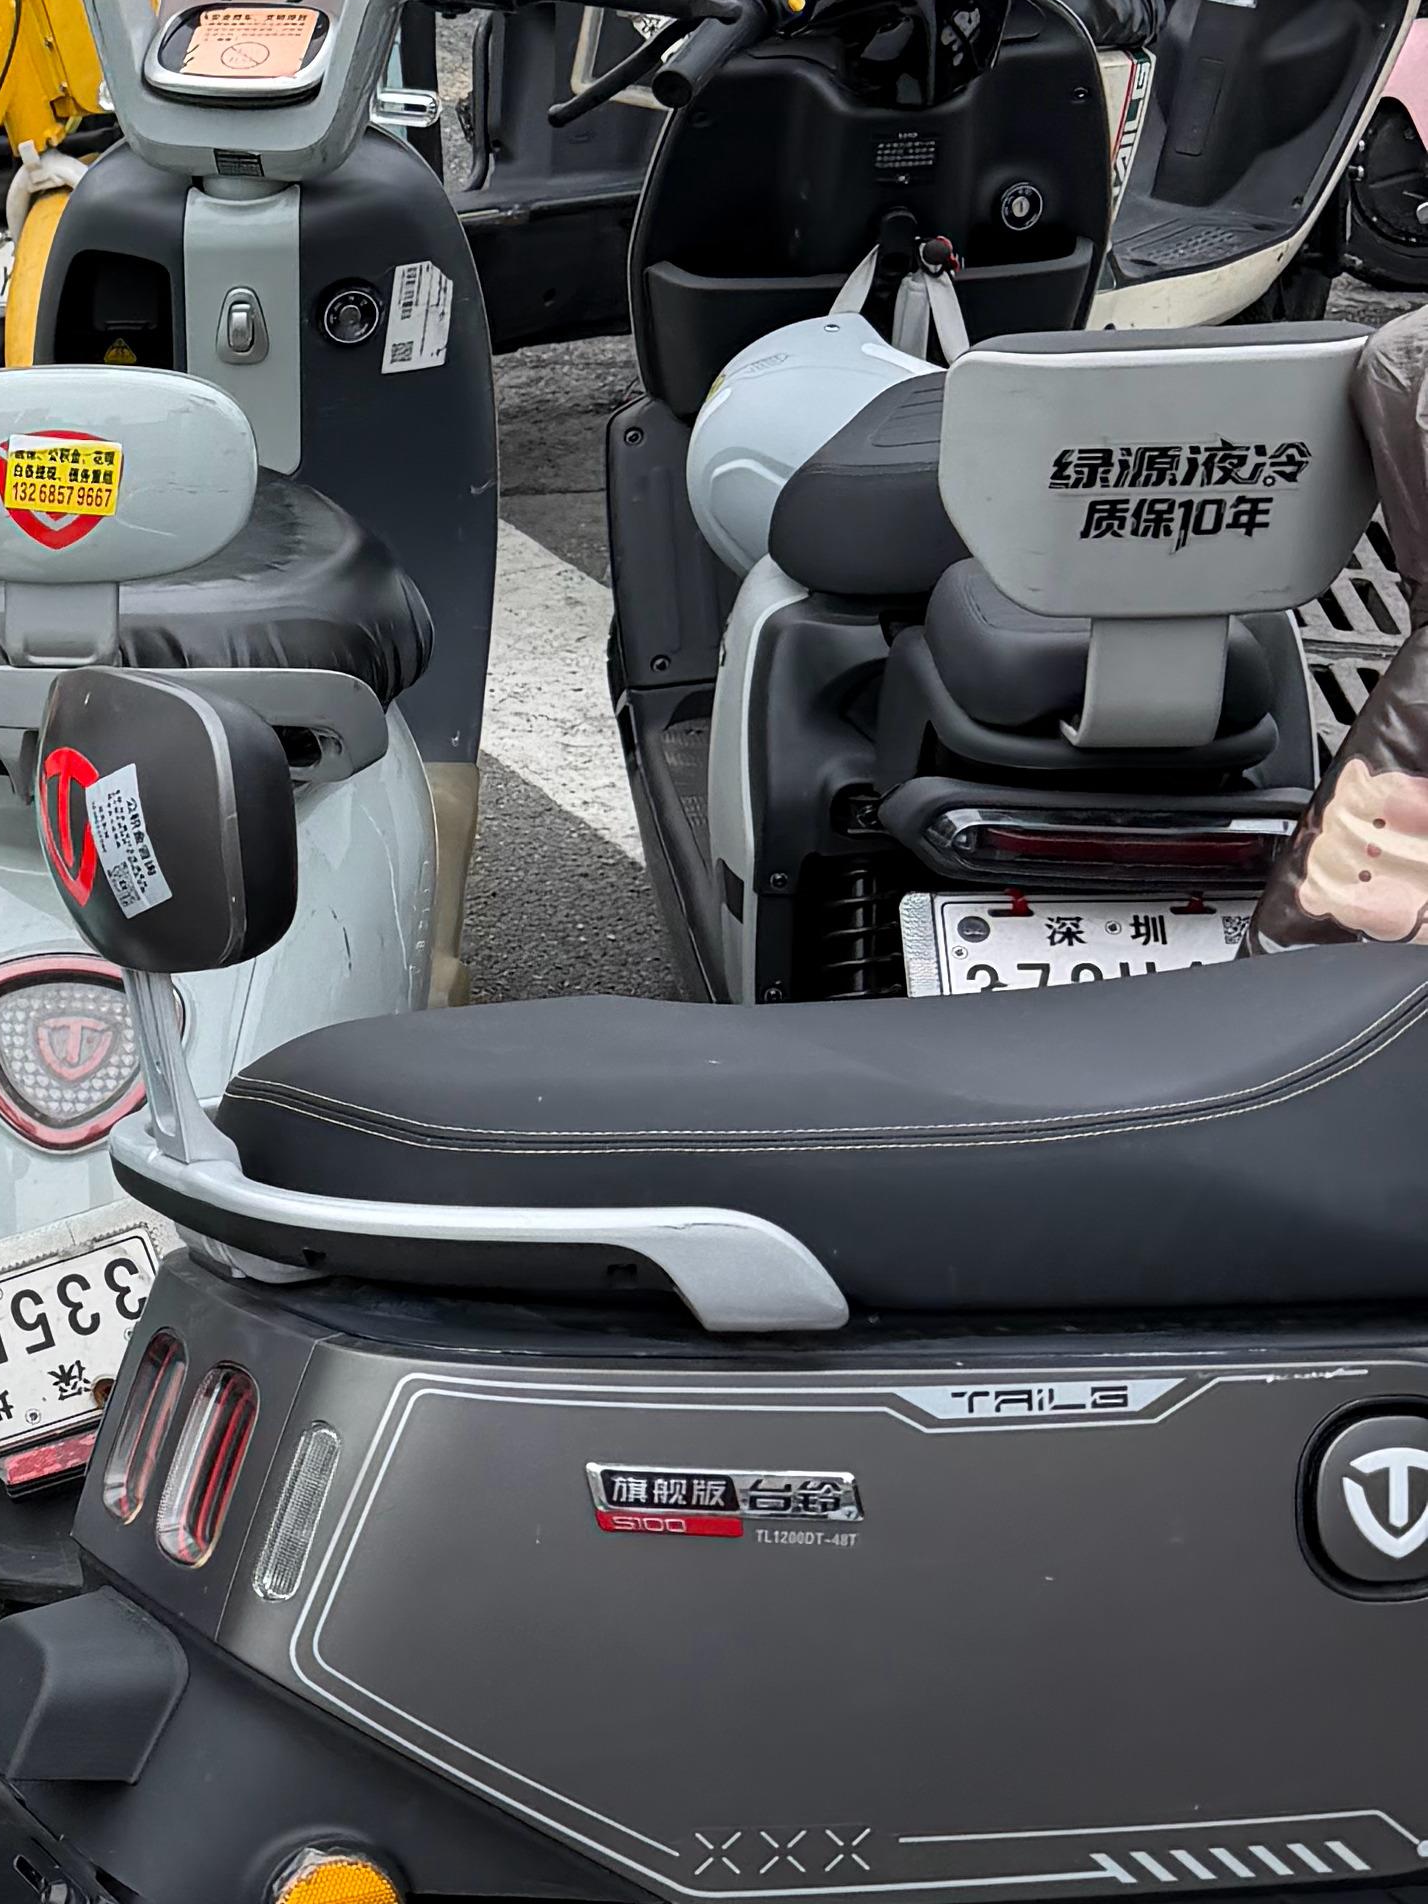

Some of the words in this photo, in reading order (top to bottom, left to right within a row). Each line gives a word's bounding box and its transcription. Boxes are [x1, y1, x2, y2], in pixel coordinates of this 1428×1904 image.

[1048, 436, 1313, 489] 绿源液冷
[12, 481, 36, 503] 132
[39, 484, 75, 506] 6857
[76, 487, 113, 508] 9667
[1079, 494, 1275, 555] 质保10年
[1045, 914, 1170, 947] 深圳
[609, 1475, 729, 1508] 旗舰版
[743, 1478, 846, 1513] 台铃
[610, 1515, 688, 1534] S100
